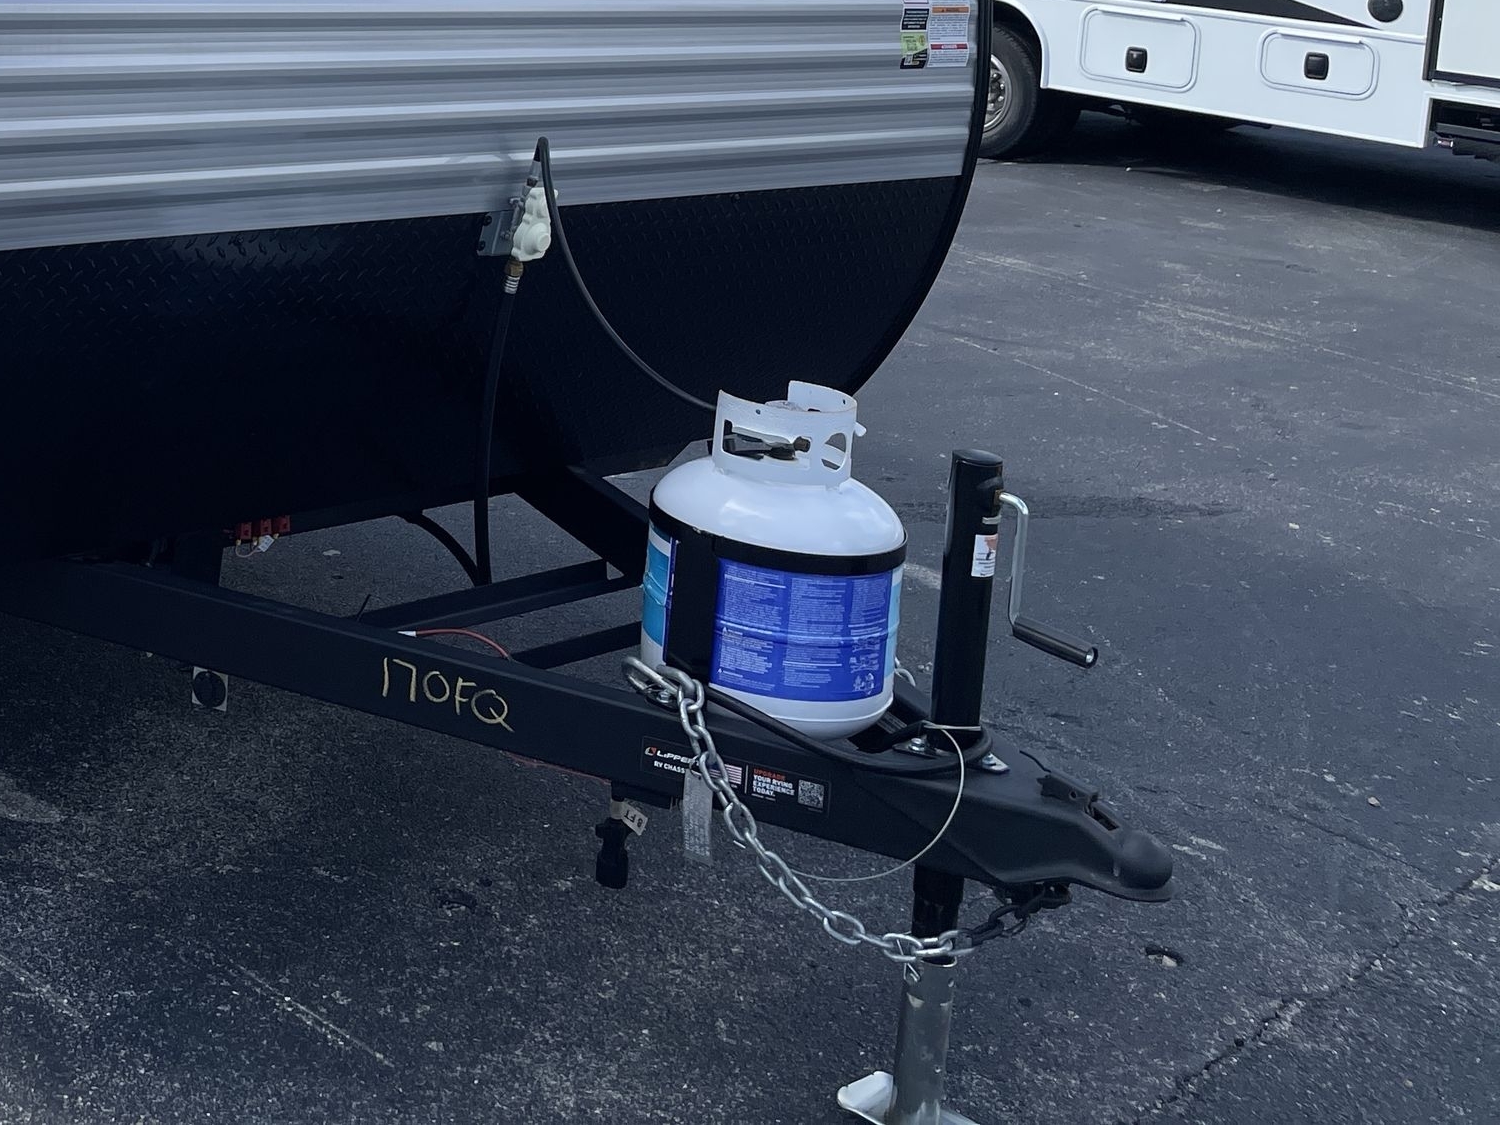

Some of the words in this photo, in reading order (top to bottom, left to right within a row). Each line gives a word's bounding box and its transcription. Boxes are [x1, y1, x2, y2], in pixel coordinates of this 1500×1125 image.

[381, 656, 515, 733] 170FQ
[653, 760, 664, 768] RV
[663, 762, 686, 774] CHASS
[753, 768, 786, 781] UPGRADE
[752, 780, 795, 796] EXPERIENCE
[753, 774, 771, 784] YOUR
[771, 778, 793, 789] RVING
[624, 809, 637, 824] FT
